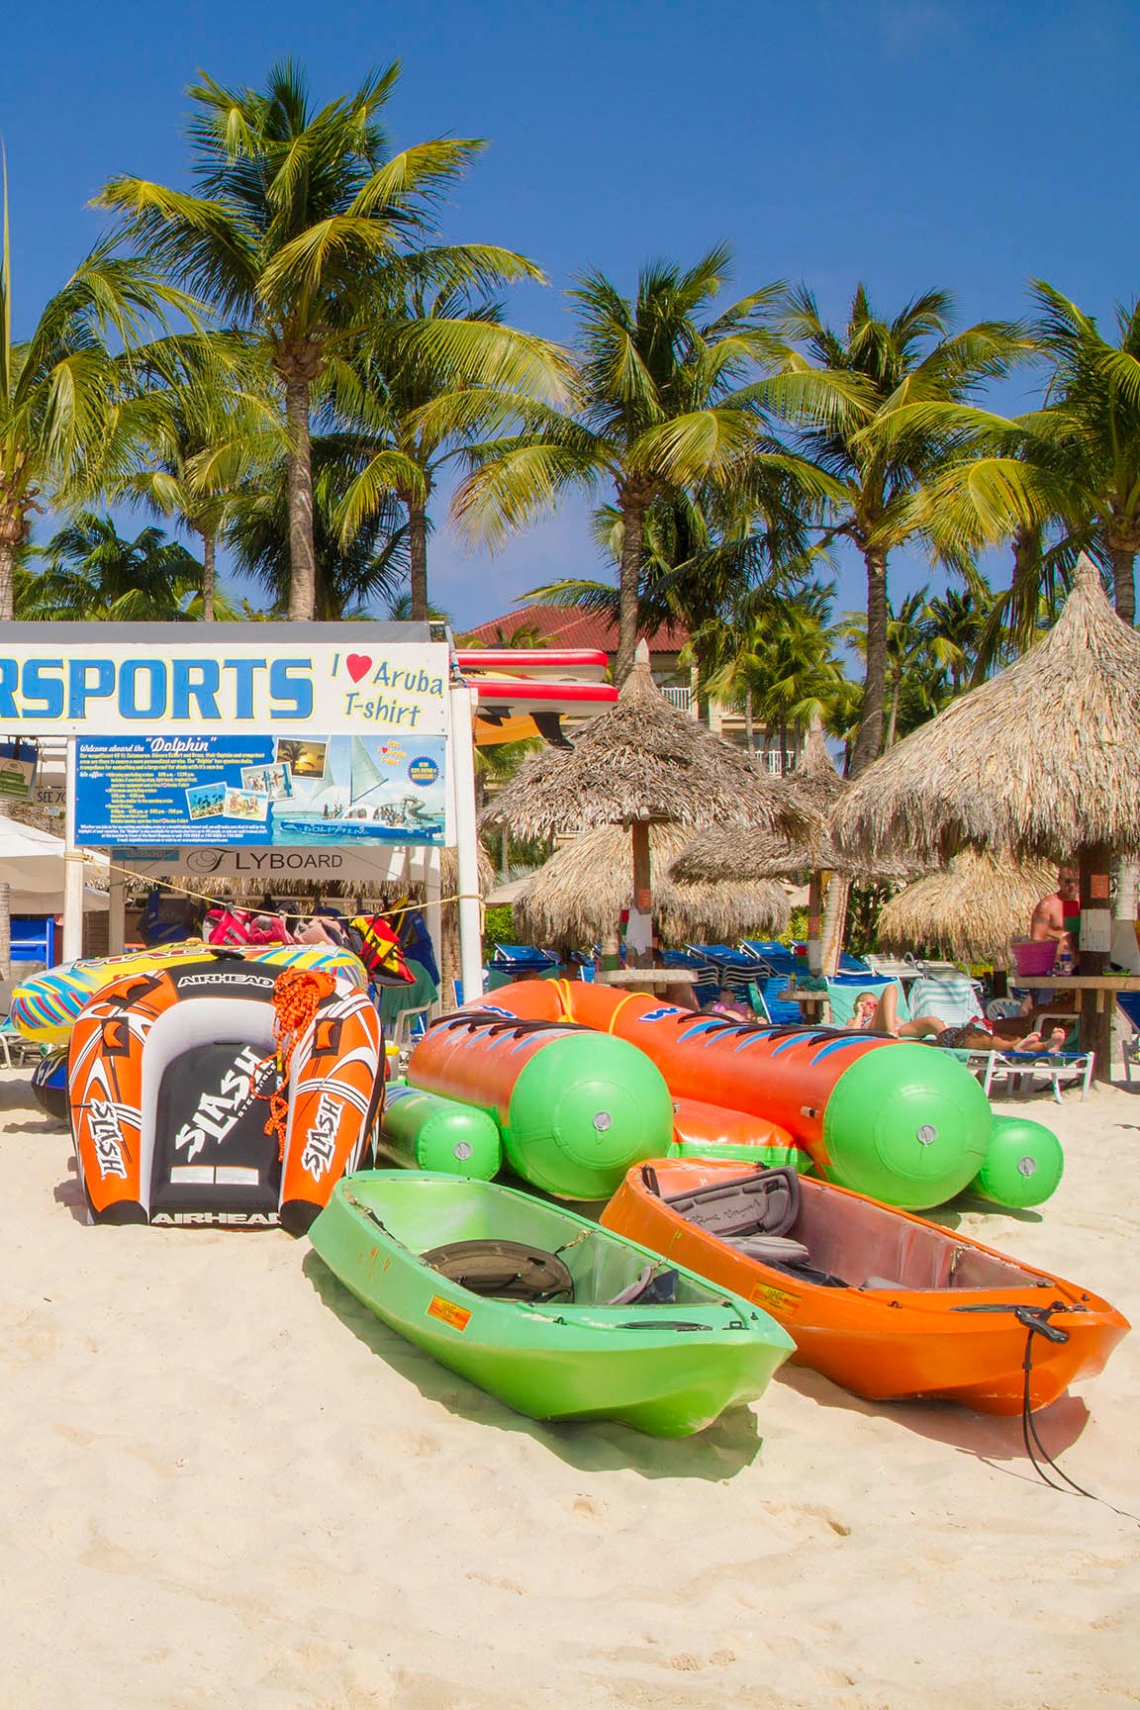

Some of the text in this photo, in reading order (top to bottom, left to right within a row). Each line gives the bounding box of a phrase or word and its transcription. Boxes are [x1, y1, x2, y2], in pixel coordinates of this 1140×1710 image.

[372, 661, 445, 697] Aruba
[344, 691, 421, 727] T-shirt
[79, 743, 108, 752] Welcome
[37, 791, 53, 803] SEE
[177, 973, 275, 989] AIRHEAD
[175, 1045, 275, 1163] SLASH
[90, 1098, 129, 1181] SLASH
[301, 1092, 346, 1183] SLASH
